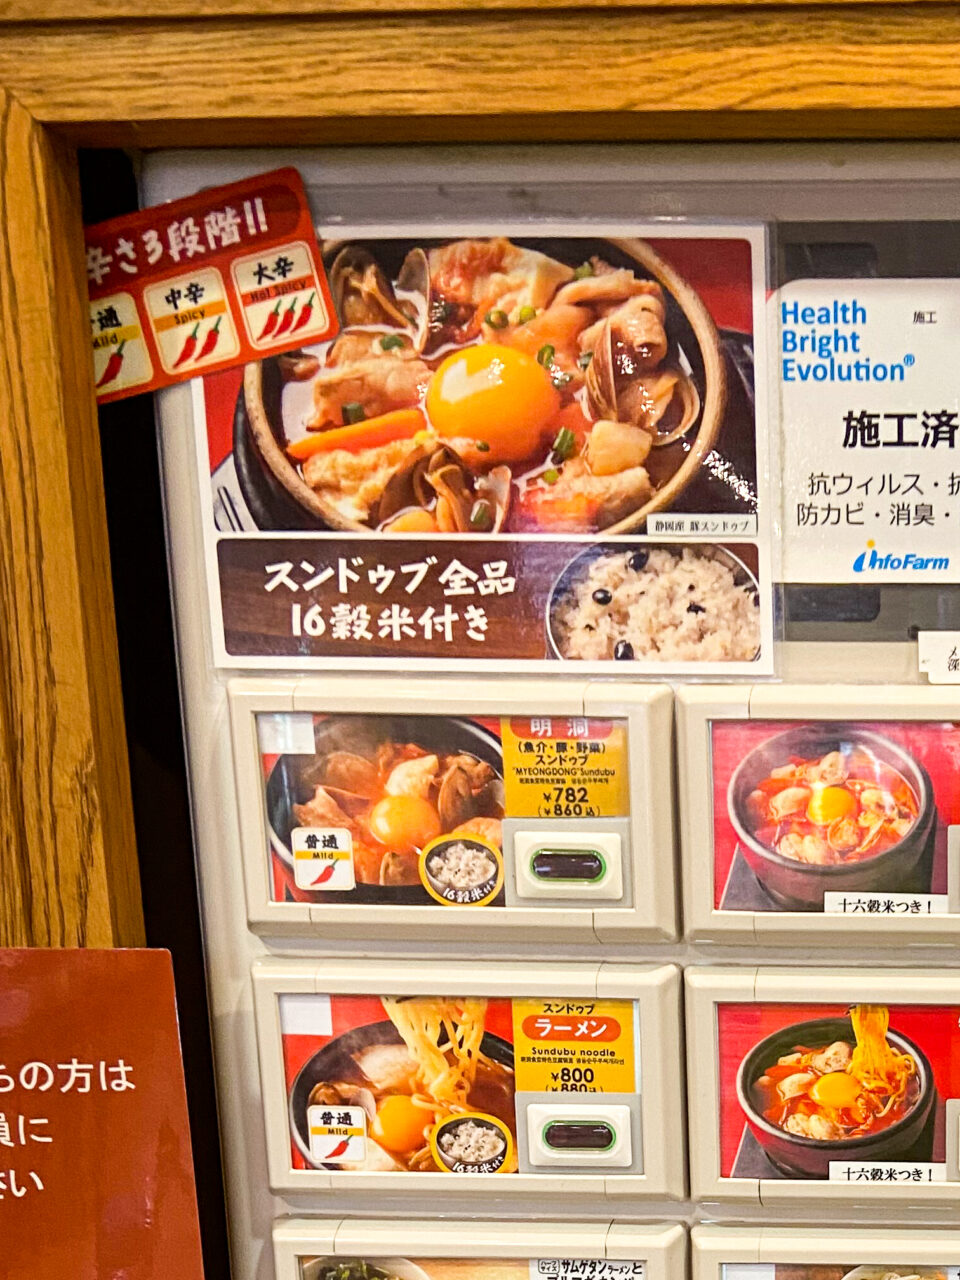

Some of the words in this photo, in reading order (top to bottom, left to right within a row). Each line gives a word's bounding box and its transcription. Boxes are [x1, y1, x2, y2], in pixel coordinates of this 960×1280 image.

[252, 256, 294, 285] 大辛
[164, 282, 205, 311] 中辛
[274, 278, 308, 298] Spicy
[174, 309, 206, 326] Spicy
[781, 299, 867, 325] Health
[913, 311, 938, 324] 施工
[782, 329, 860, 358] Bright
[842, 410, 960, 449] 施工済
[263, 556, 517, 597] スンドゥブ全品
[290, 604, 490, 644] 16穀米付き
[530, 717, 589, 737] 明洞
[535, 754, 589, 766] スンドゥブ
[543, 787, 589, 803] ¥782
[304, 834, 339, 849] 普通
[312, 852, 334, 860] Mild
[543, 1003, 595, 1014] スンドゥブ
[535, 1018, 607, 1038] ラーメン
[531, 1047, 576, 1056] Sundubu
[580, 1048, 616, 1057] noodle
[551, 1067, 594, 1083] ¥800
[320, 1111, 354, 1126] 普通
[327, 1128, 348, 1136] Mild
